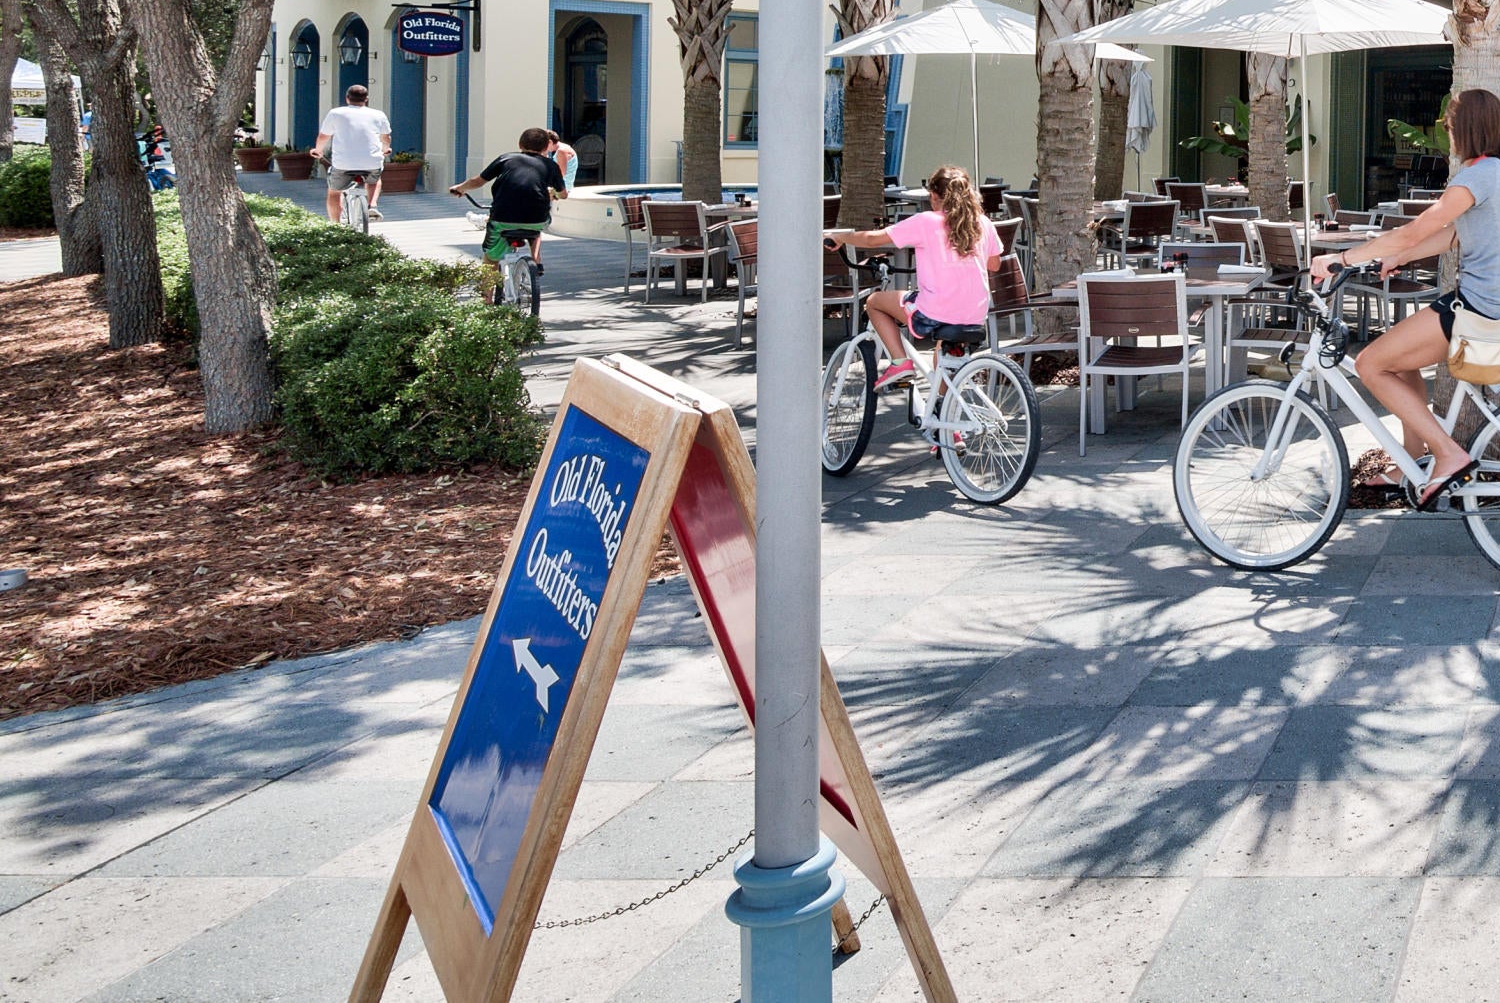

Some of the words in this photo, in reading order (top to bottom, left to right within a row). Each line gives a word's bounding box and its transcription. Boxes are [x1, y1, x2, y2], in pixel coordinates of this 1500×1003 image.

[403, 18, 423, 29] Old
[425, 17, 461, 32] Florida
[403, 30, 460, 41] Outfitters
[550, 454, 588, 507] Old
[578, 455, 627, 570] Florida
[526, 528, 598, 640] Outfitters
